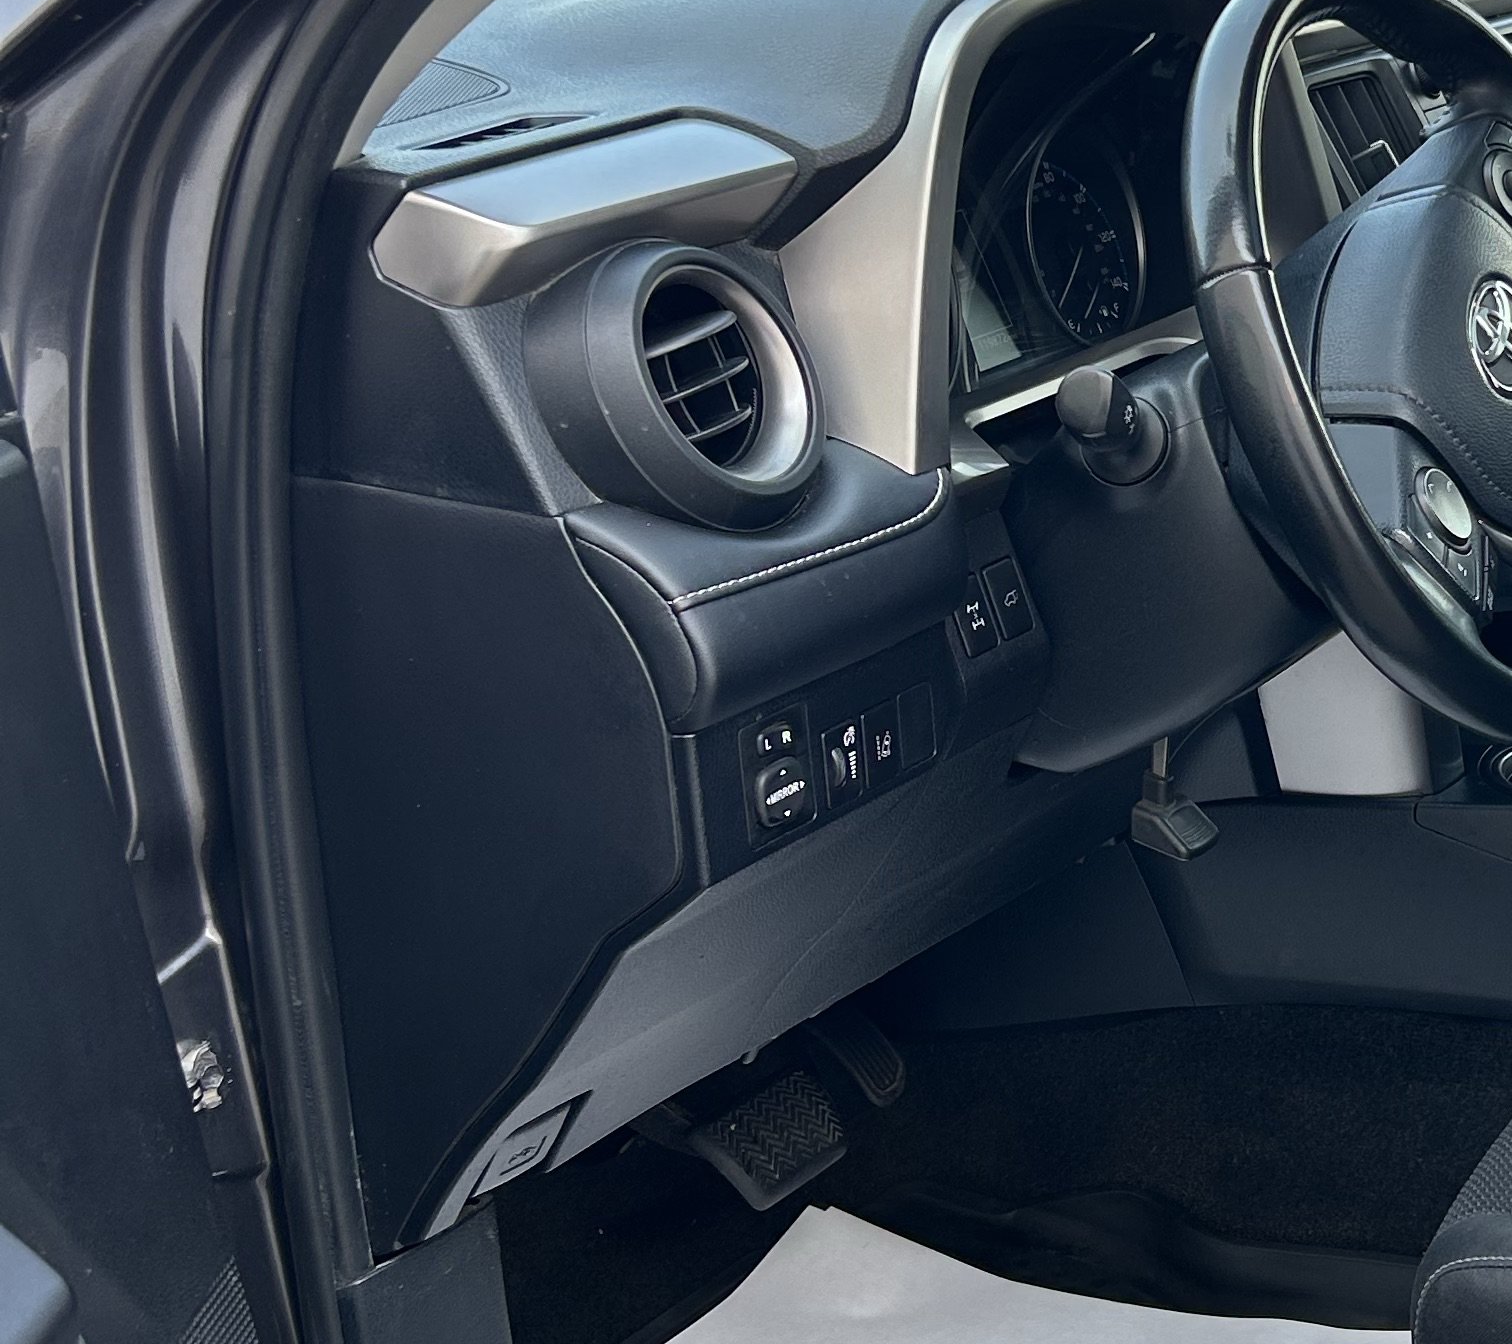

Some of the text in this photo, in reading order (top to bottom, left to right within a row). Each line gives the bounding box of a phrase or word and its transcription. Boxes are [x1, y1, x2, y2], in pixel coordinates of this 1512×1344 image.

[764, 730, 792, 750] L R
[769, 781, 800, 805] MIRROR
